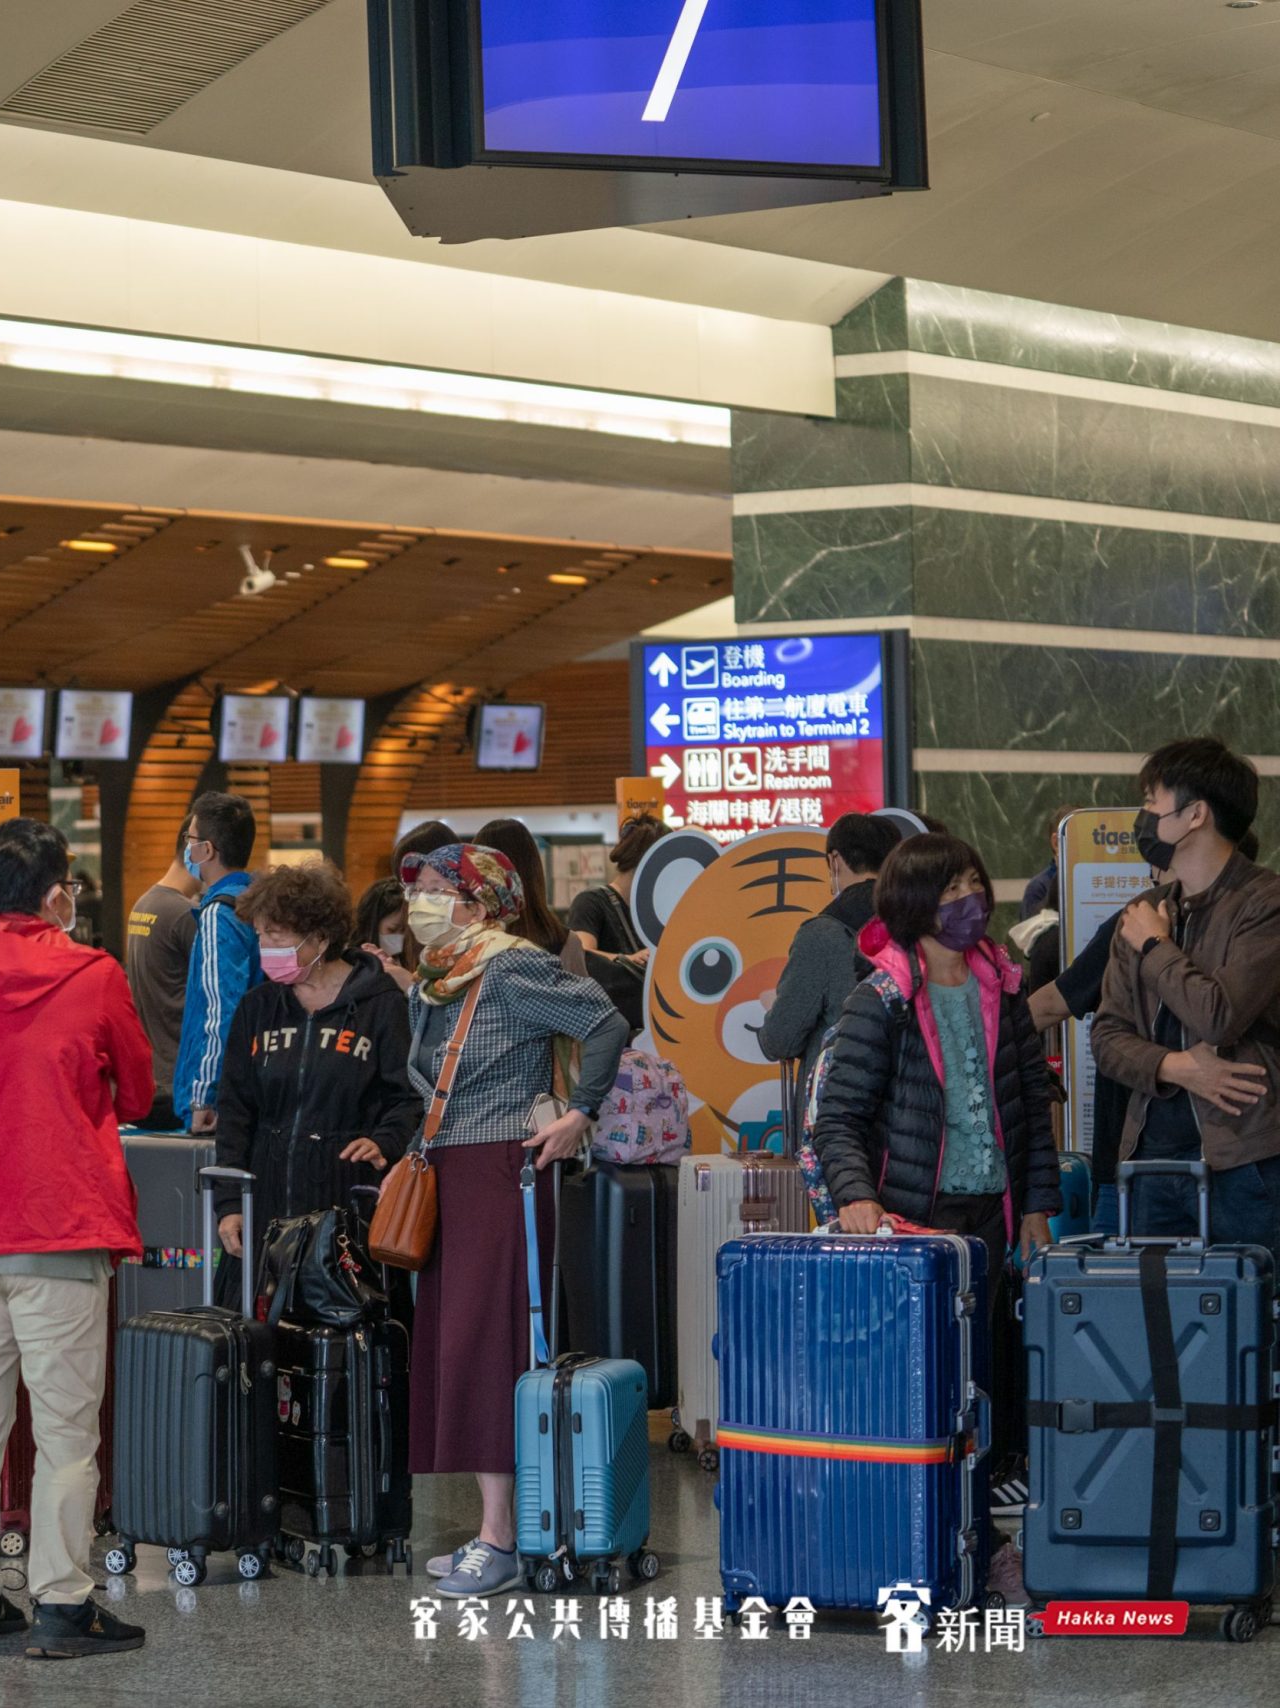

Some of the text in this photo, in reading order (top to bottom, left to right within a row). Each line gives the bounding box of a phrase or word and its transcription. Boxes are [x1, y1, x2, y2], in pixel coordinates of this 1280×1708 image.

[722, 644, 766, 670] 登機
[721, 671, 786, 691] Boarding
[723, 718, 870, 743] Skytrain to Terminal 2
[763, 746, 830, 772] 洗手間
[764, 774, 832, 790] Restroom
[320, 1027, 373, 1062] TER
